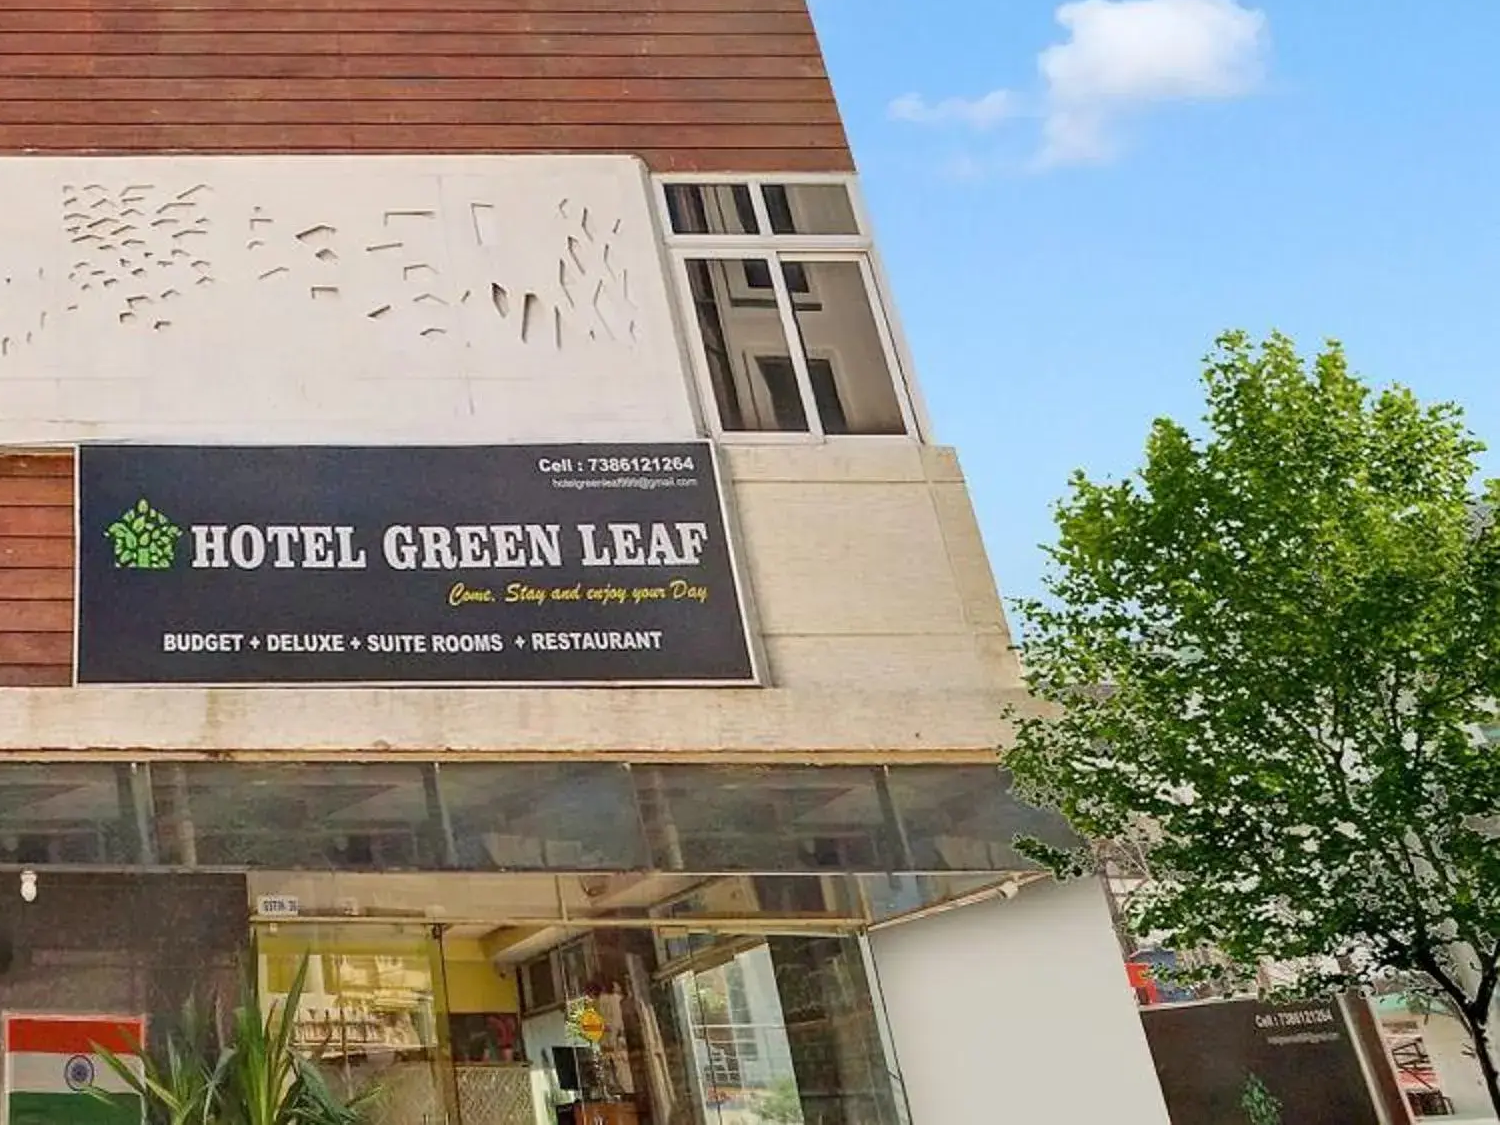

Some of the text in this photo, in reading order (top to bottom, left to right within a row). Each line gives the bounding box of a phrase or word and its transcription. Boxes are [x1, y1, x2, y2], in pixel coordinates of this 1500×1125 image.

[538, 458, 573, 473] Cell
[587, 456, 695, 472] 7386121264
[191, 522, 708, 570] HOTEL GREEN LEAF
[505, 582, 548, 606] Stay
[549, 583, 582, 601] and
[586, 583, 627, 605] enjoy
[631, 585, 666, 604] your
[669, 580, 709, 604] Day
[163, 633, 244, 652] BUDGET
[267, 634, 345, 652] DELUXE
[367, 634, 427, 653] SUITE
[431, 633, 503, 653] ROOMS
[531, 631, 663, 651] RESTAURANT
